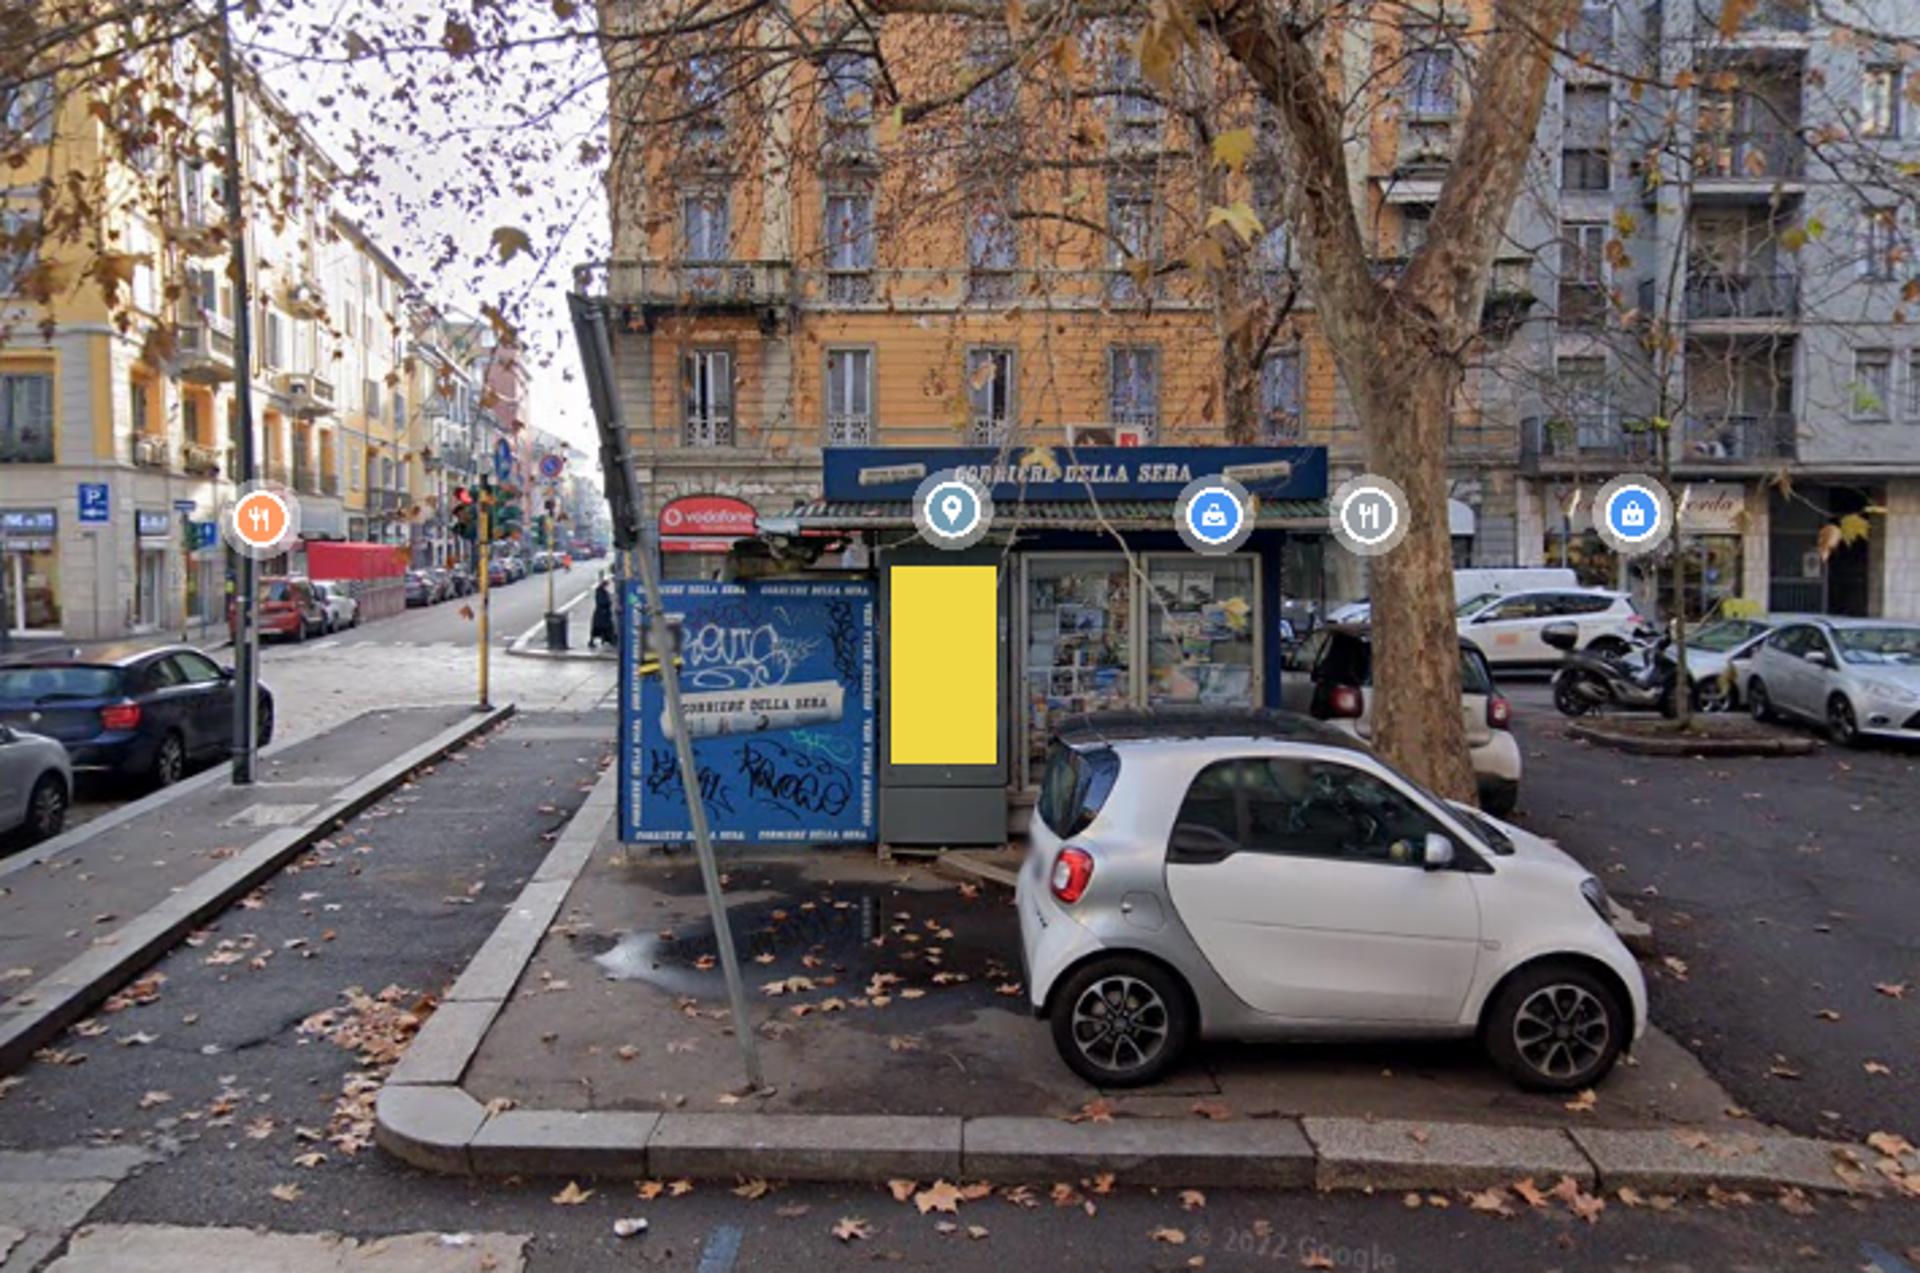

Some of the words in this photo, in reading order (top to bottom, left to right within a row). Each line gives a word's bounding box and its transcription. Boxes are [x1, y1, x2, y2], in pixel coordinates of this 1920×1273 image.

[1064, 464, 1129, 483] DELLA
[1138, 462, 1191, 483] SERA
[685, 509, 756, 523] vodafone
[795, 697, 828, 709] SERA
